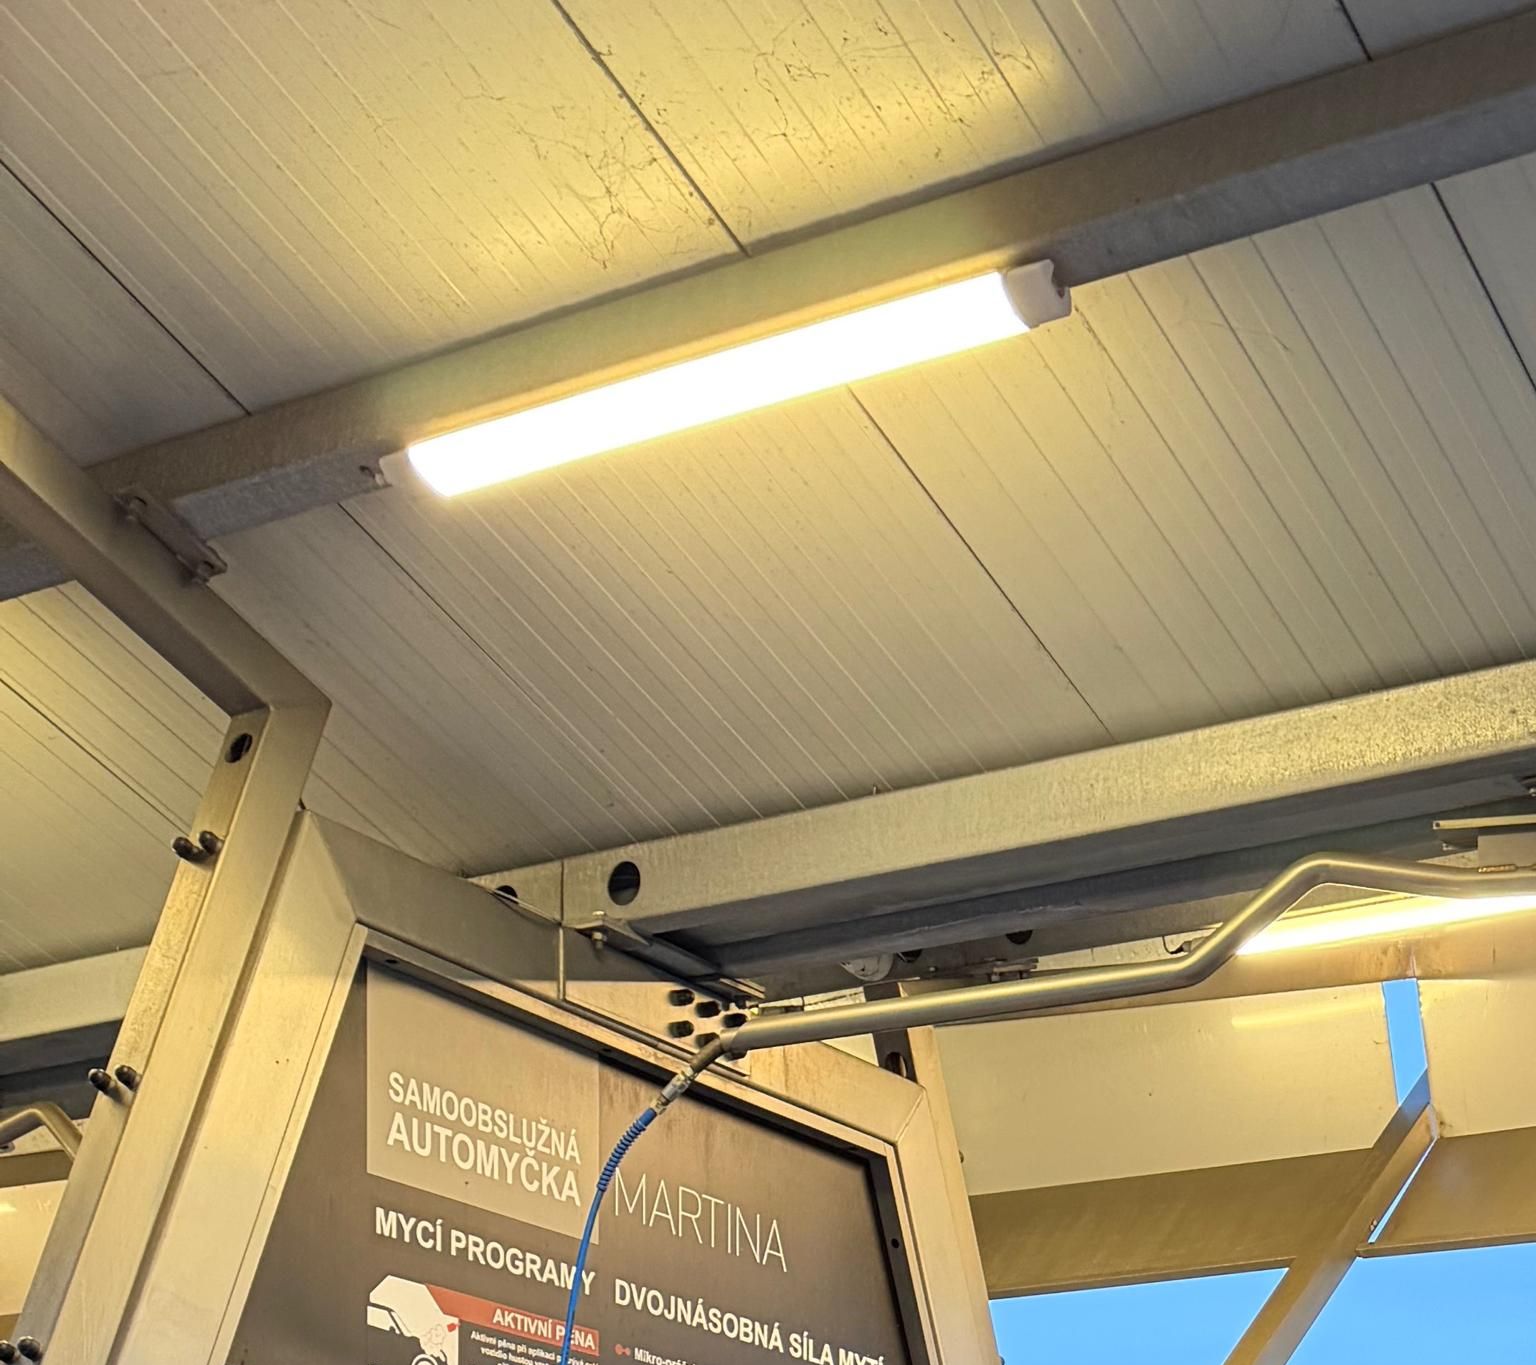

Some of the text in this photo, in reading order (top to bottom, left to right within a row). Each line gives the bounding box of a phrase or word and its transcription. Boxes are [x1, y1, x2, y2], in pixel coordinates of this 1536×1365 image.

[387, 1112, 580, 1207] AUTOMYČKA
[389, 1072, 581, 1165] SAMOOBSLUŽNÁ
[375, 1206, 443, 1252] MYCÍ
[614, 1167, 787, 1273] MARTINA
[493, 1309, 552, 1338] AKTIVNÍ
[615, 1278, 783, 1353] DVOJNÁSOBNÁ
